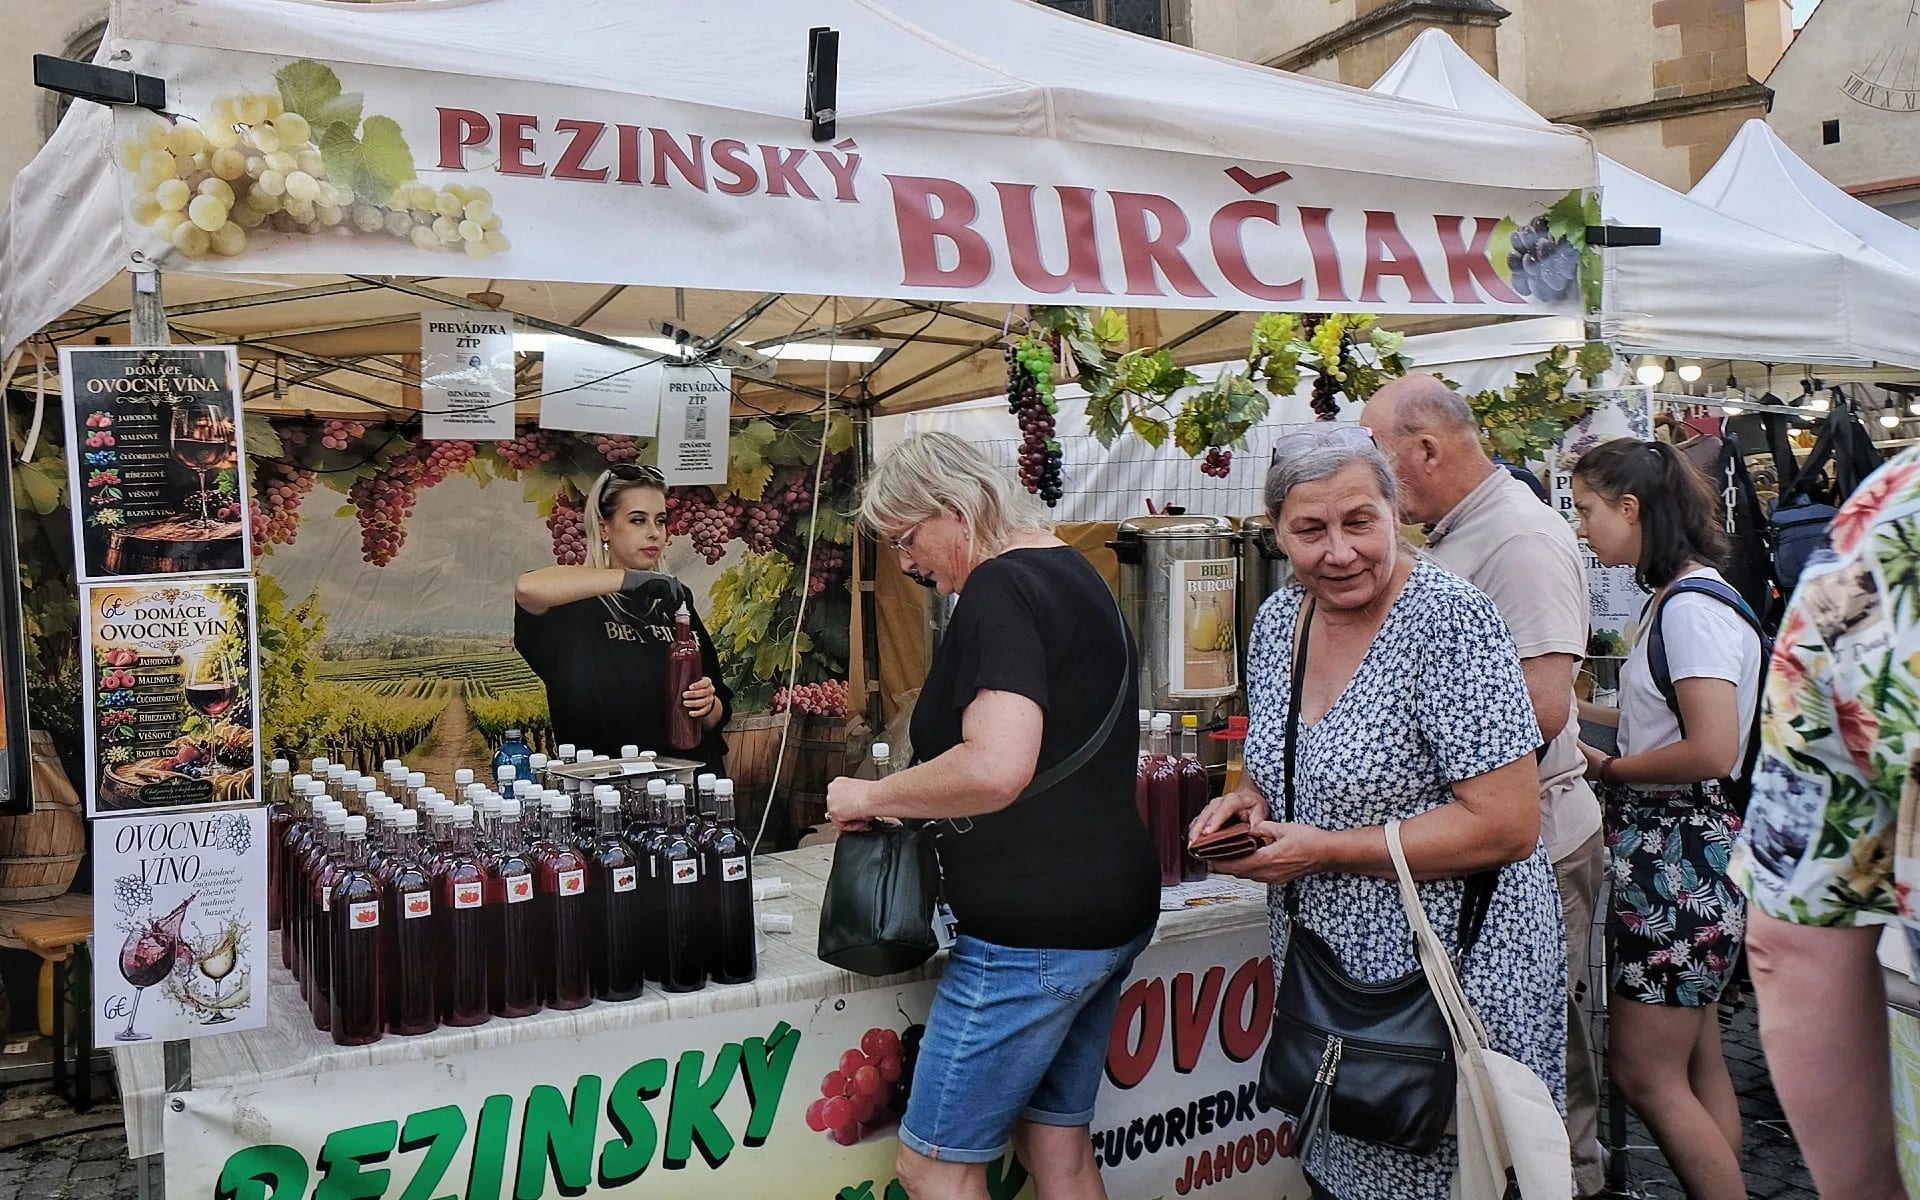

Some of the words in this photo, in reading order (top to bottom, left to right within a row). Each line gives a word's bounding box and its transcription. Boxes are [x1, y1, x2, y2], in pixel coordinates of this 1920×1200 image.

[1843, 75, 1864, 95] VIII
[1902, 93, 1916, 109] XI
[435, 106, 863, 203] PEZINSKÝ
[882, 165, 1530, 305] BURČIAK
[429, 321, 507, 335] PREVÁDZKA
[456, 335, 480, 348] ZŤP
[125, 365, 182, 376] DOMÁCE
[87, 374, 169, 393] OVOCNÉ
[173, 373, 219, 392] VÍNA
[117, 413, 158, 422] JAHODOVÉ
[120, 432, 159, 440] MALINOVÉ
[101, 594, 126, 619] 6€
[134, 606, 206, 621] DOMÁCE
[100, 619, 189, 641] OVOCNÉ
[194, 618, 244, 636] VÍNA
[139, 657, 176, 666] JAHODOVÉ
[138, 675, 175, 685] MALINOVÉ
[115, 814, 220, 854] OVOCNÉ
[138, 852, 200, 886] VÍNO
[104, 995, 131, 1019] 6€
[1104, 955, 1276, 1090] OVO
[1091, 1081, 1268, 1169] ČUČORIEDK
[1175, 1121, 1295, 1195] JAHODO
